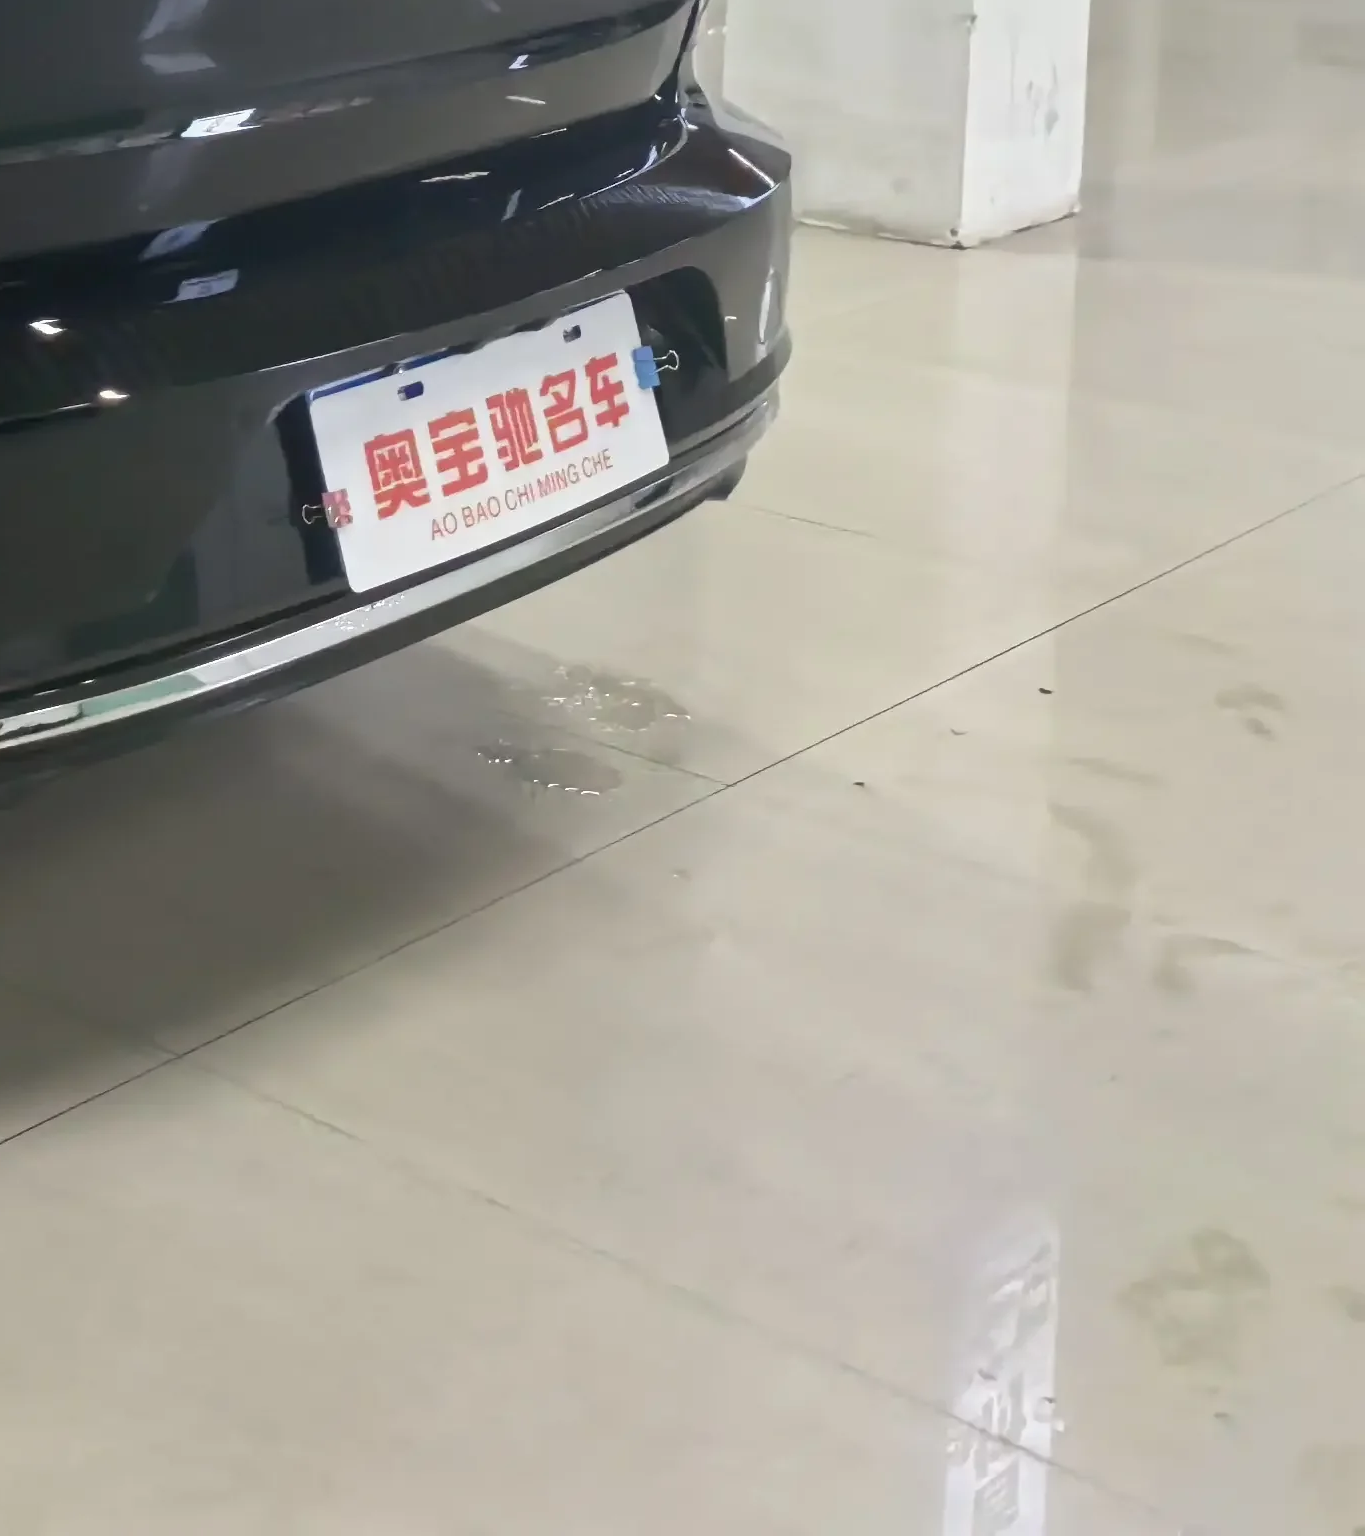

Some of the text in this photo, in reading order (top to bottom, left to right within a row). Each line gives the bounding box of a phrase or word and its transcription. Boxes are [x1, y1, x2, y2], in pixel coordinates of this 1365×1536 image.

[362, 352, 630, 521] 奥宝驰名车
[430, 448, 614, 541] AO BAO CHI MING CHE
